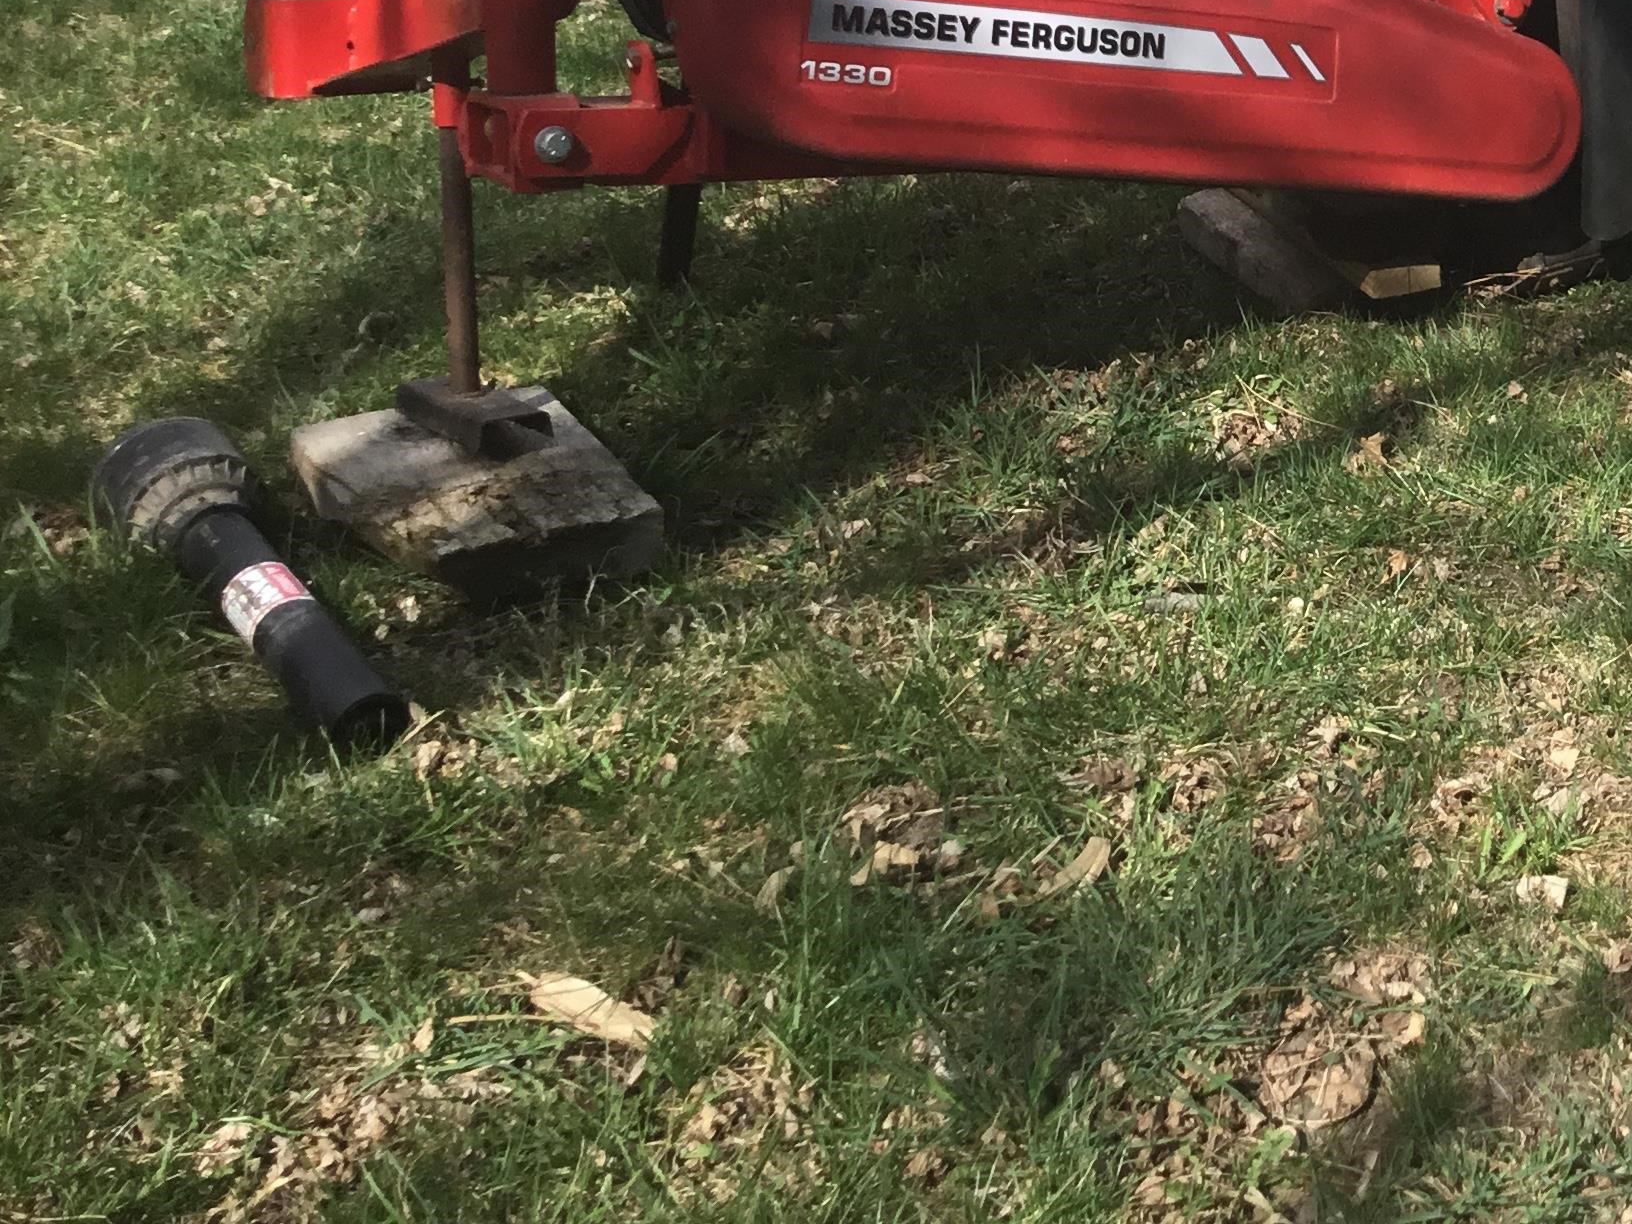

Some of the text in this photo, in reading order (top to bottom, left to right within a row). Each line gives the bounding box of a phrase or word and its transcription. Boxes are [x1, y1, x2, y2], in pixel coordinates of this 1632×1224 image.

[831, 3, 1165, 60] MASSEY FERGUSON
[800, 60, 892, 86] 1330
